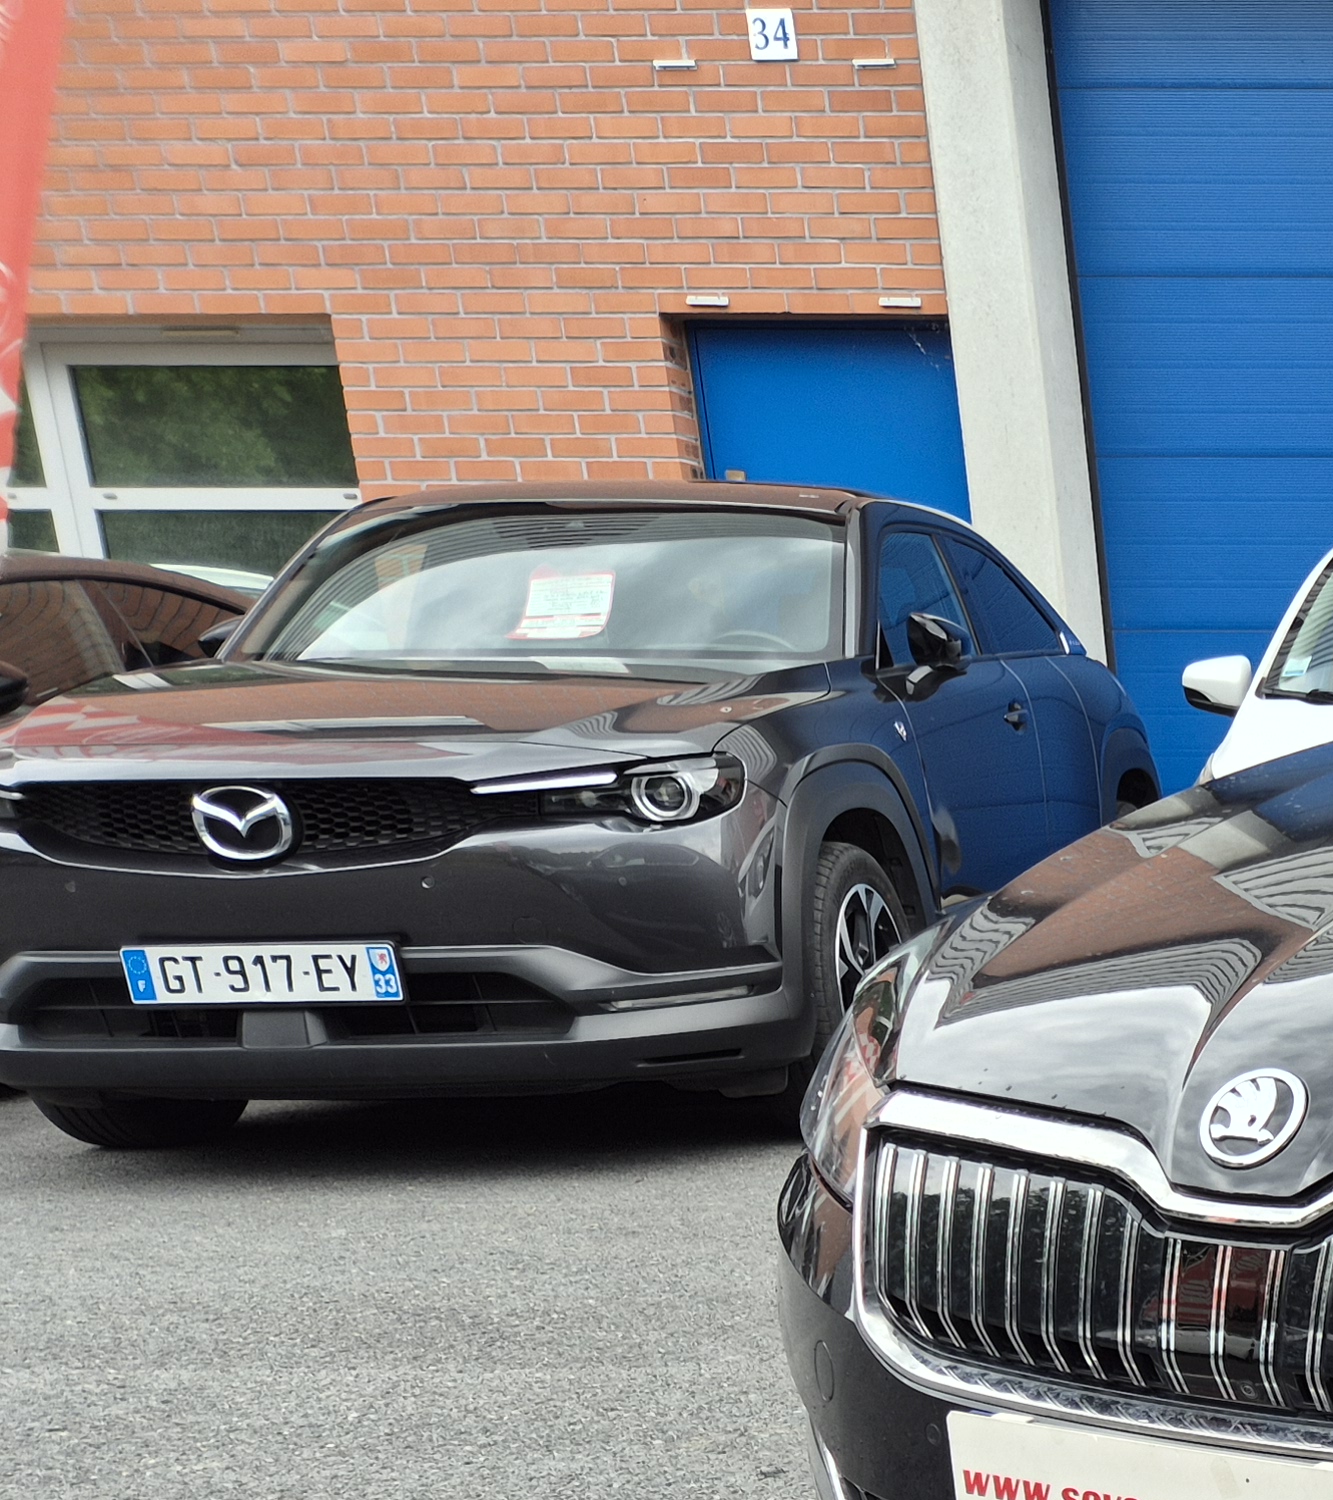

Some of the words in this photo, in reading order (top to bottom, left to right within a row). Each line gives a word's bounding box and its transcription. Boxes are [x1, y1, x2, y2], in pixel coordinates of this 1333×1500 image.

[752, 17, 790, 50] 34
[158, 954, 358, 994] GT-917-EY
[374, 973, 397, 994] 33
